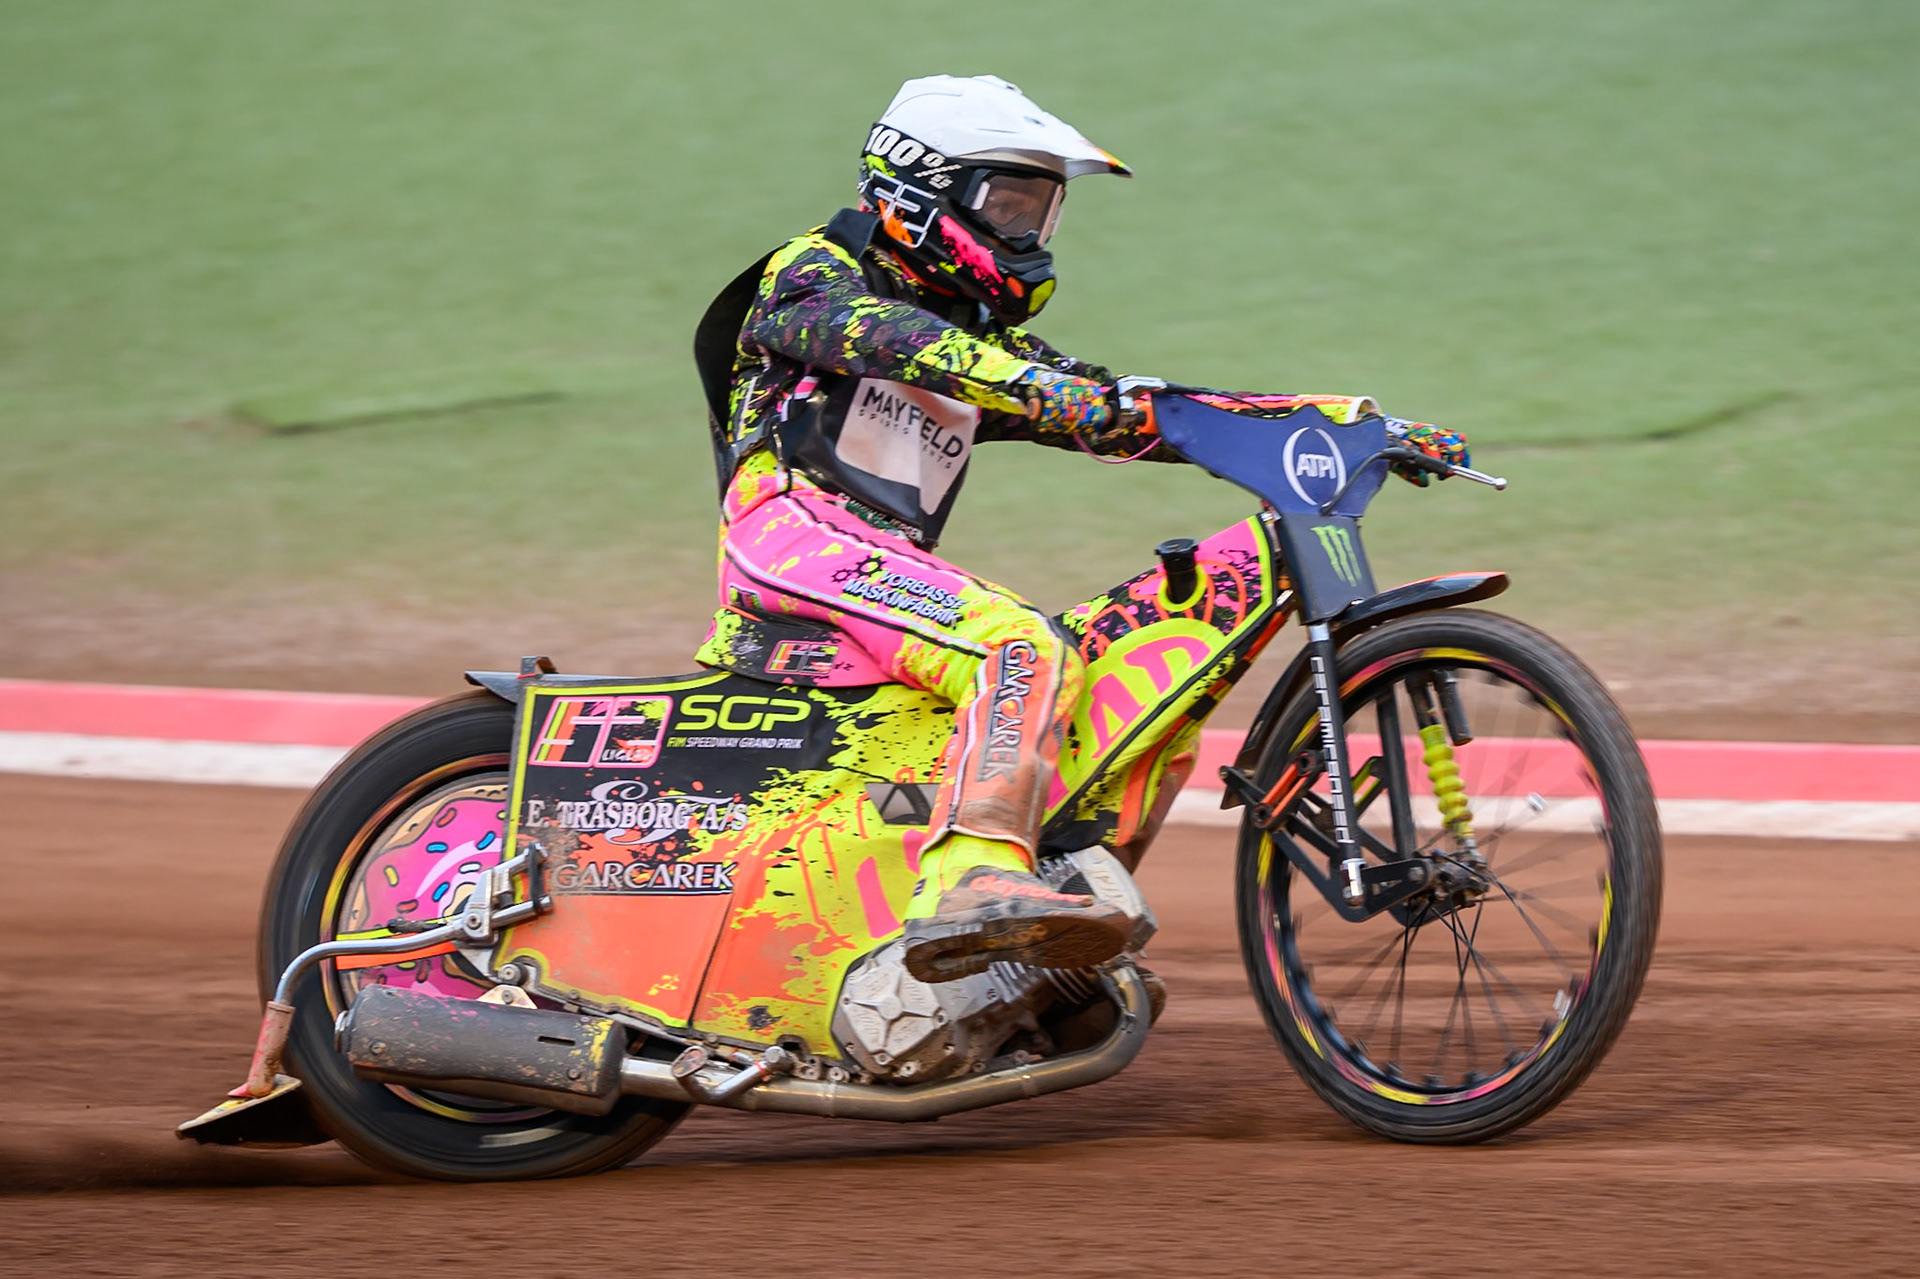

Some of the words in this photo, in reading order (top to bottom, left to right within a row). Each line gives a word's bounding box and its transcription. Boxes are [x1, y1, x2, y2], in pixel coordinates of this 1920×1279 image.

[864, 125, 962, 189] 100%
[863, 386, 963, 457] MAYFELD
[1296, 453, 1337, 480] ATPI
[843, 579, 963, 626] MASKINFABRIK
[881, 569, 966, 608] VORBASSE
[675, 694, 811, 731] SGP
[983, 640, 1038, 783] GARCAREK
[666, 737, 686, 748] FIM
[686, 737, 740, 748] SPEEDWAY
[738, 738, 777, 749] GRAND
[775, 739, 804, 749] PRIX
[1310, 656, 1355, 843] CERAMICSPEED
[525, 800, 550, 828] E.
[557, 800, 691, 830] TRASBORG
[700, 801, 748, 831] A/S
[553, 862, 738, 889] GARCAREK
